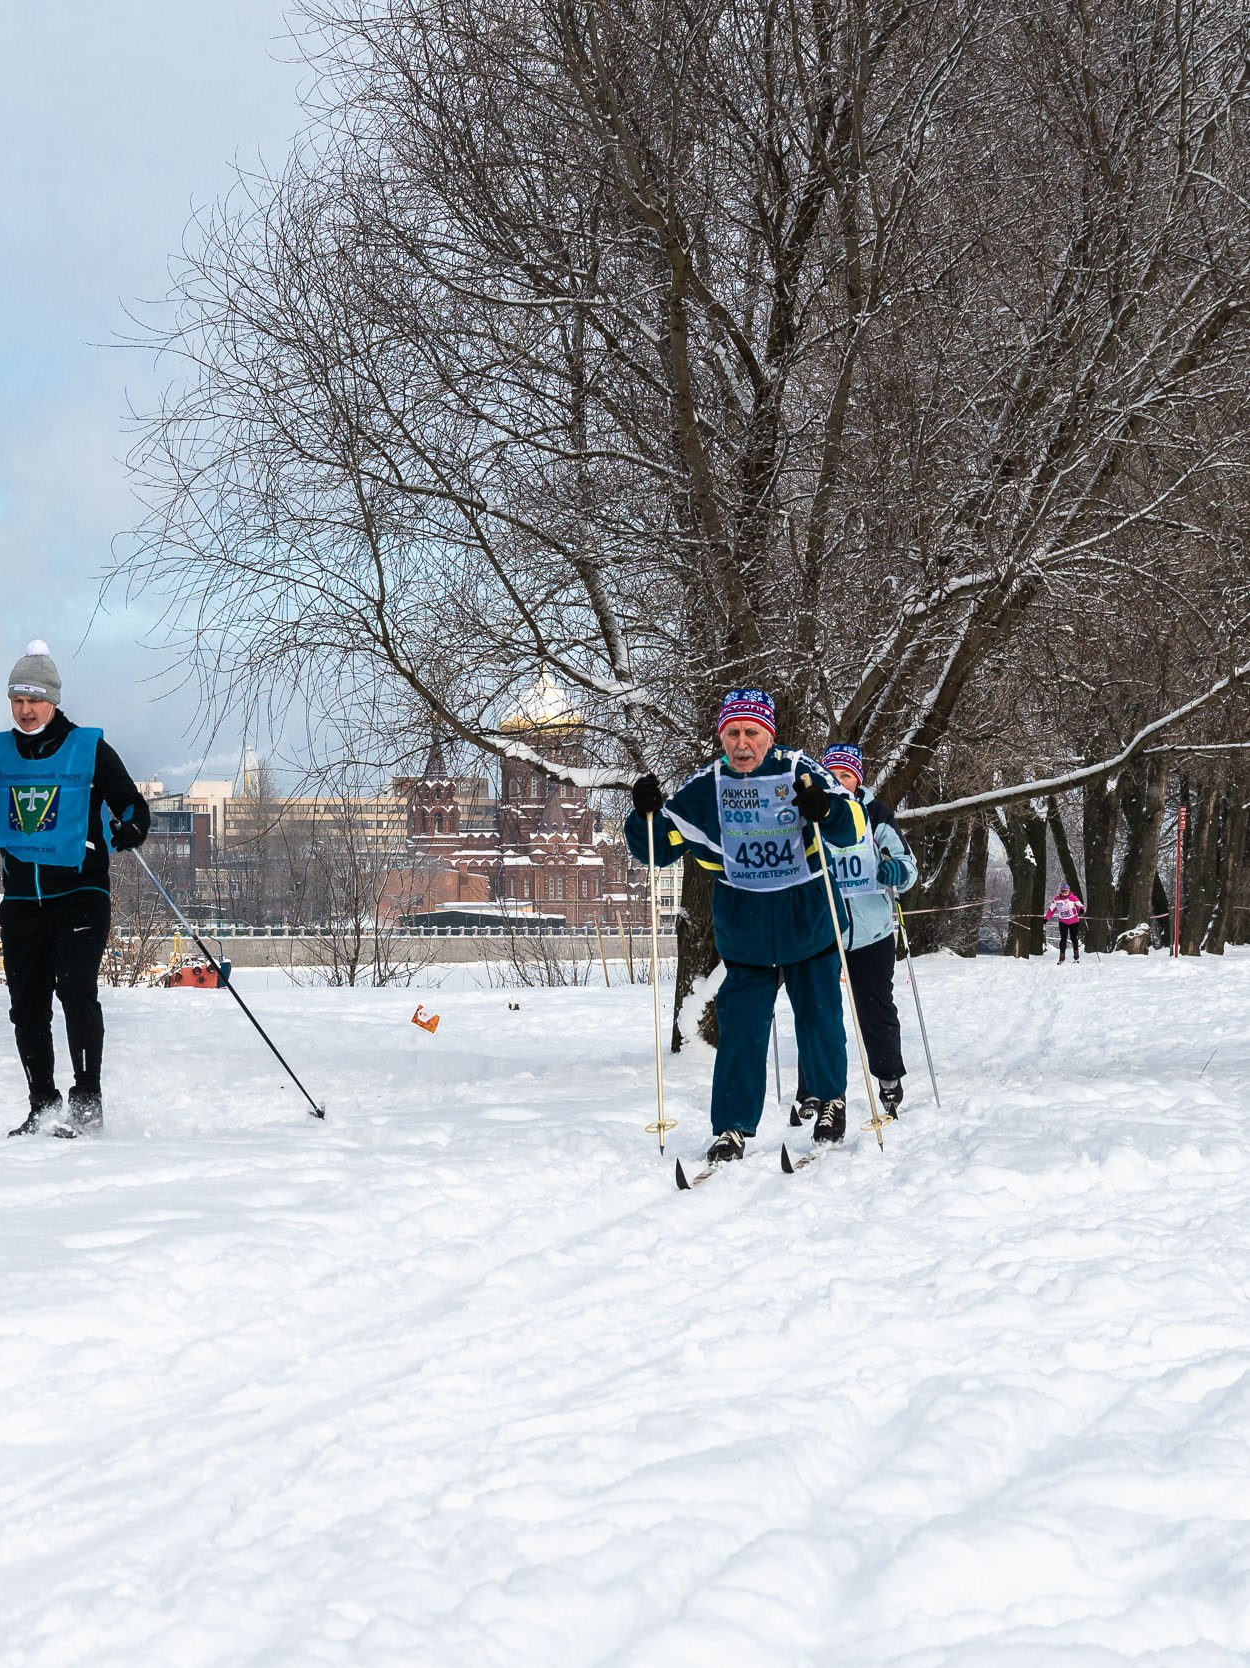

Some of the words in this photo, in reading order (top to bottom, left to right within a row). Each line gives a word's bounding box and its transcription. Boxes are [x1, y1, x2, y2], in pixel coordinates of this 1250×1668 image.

[721, 788, 759, 799] ЛЫЖНЯ
[722, 799, 760, 809] РОССИИ
[724, 810, 760, 823] 2021
[735, 839, 795, 869] 4384
[731, 865, 801, 880] САНКТ-ПЕТЕРБУРГ
[837, 878, 870, 889] ЕТЕРБУРГ
